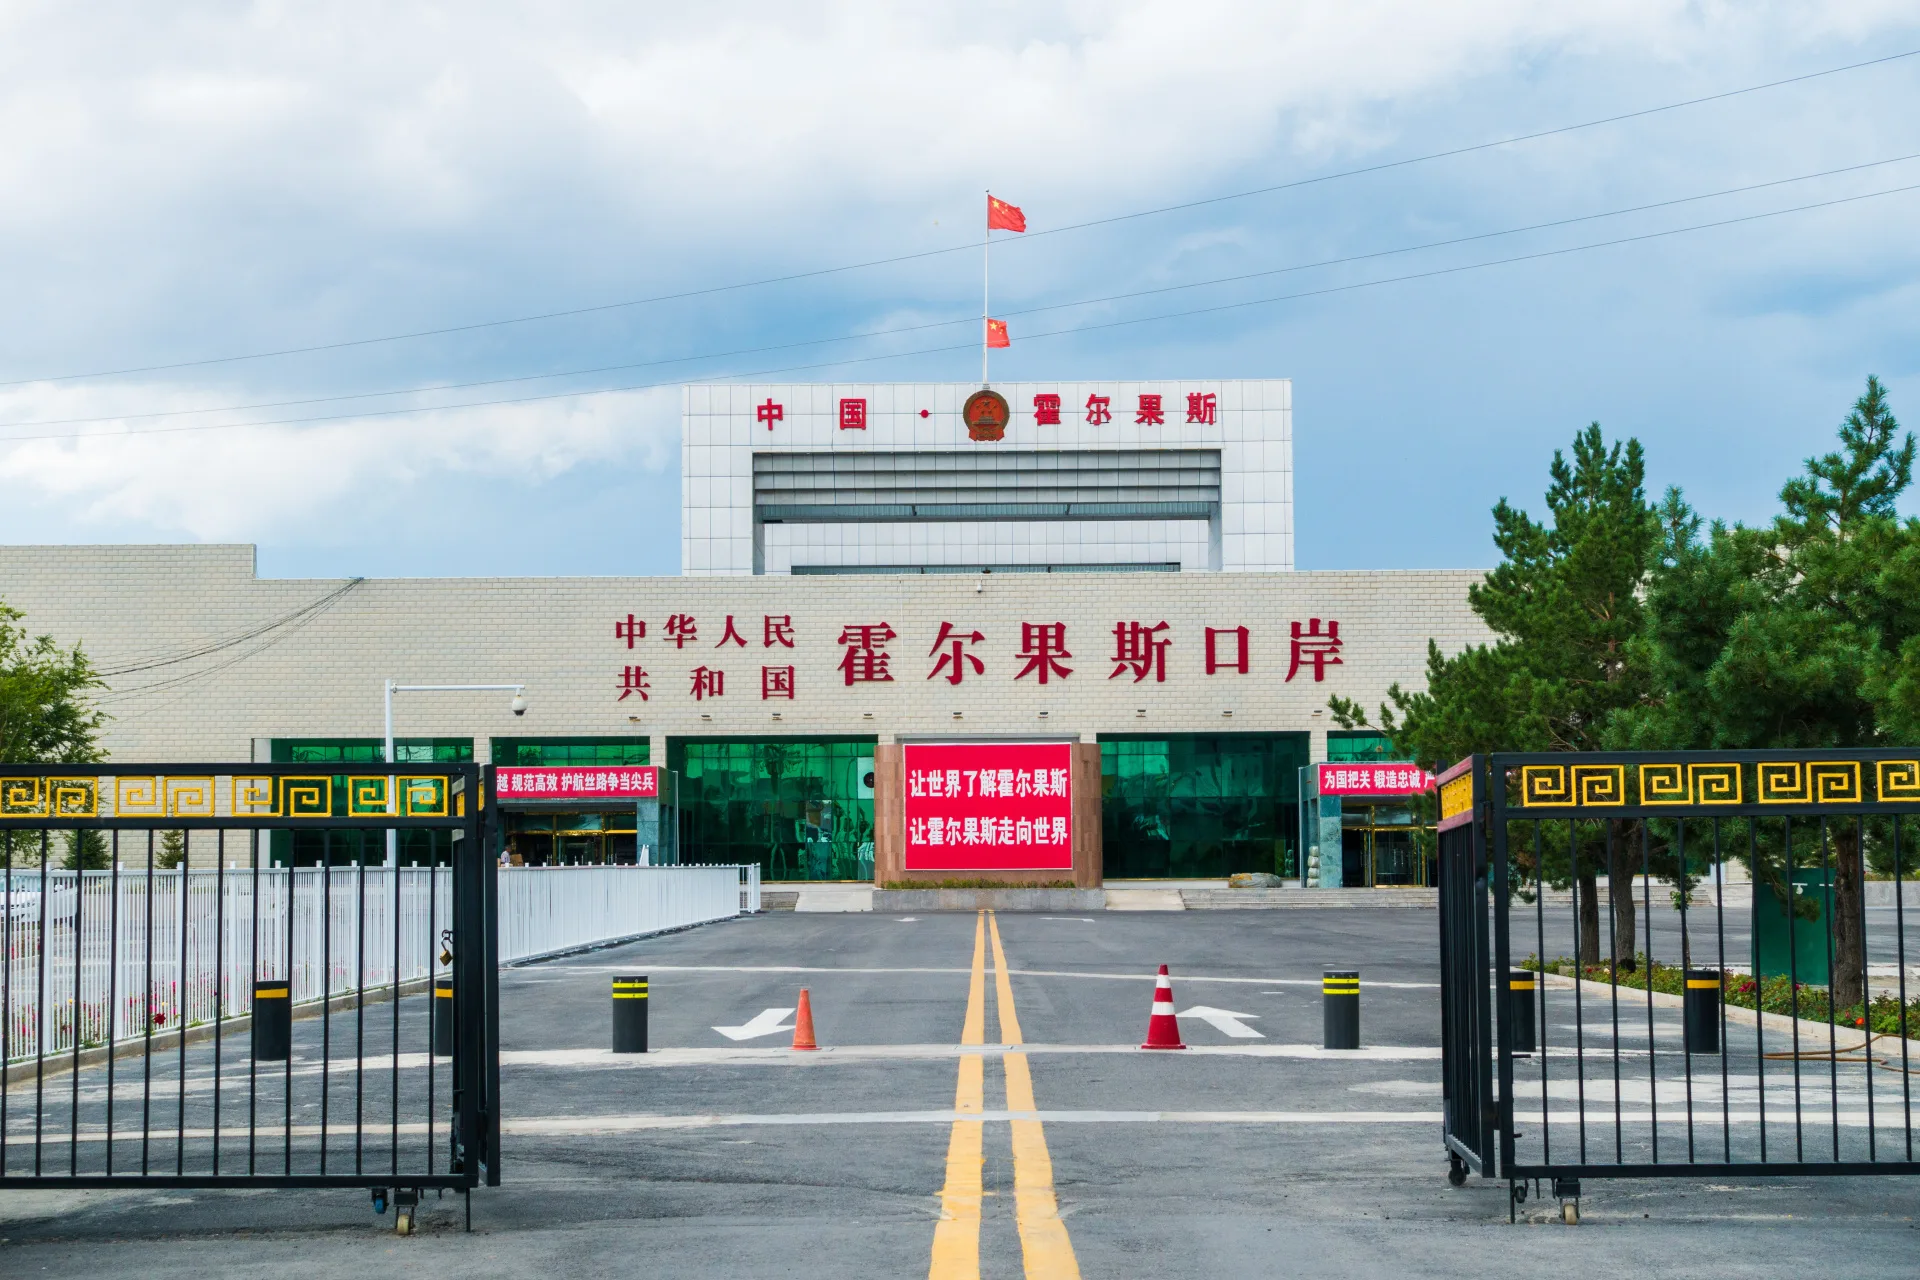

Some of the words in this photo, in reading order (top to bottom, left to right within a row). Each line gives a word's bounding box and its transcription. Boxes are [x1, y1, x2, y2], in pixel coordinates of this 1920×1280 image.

[616, 614, 795, 649] 中华人民
[838, 618, 1343, 686] 霍尔果斯口岸
[618, 665, 795, 701] 共和国
[909, 768, 1068, 798] 让世界了解霍尔果斯
[1324, 770, 1371, 789] 为国把关
[909, 816, 1068, 846] 让霍尔果斯走向世界
